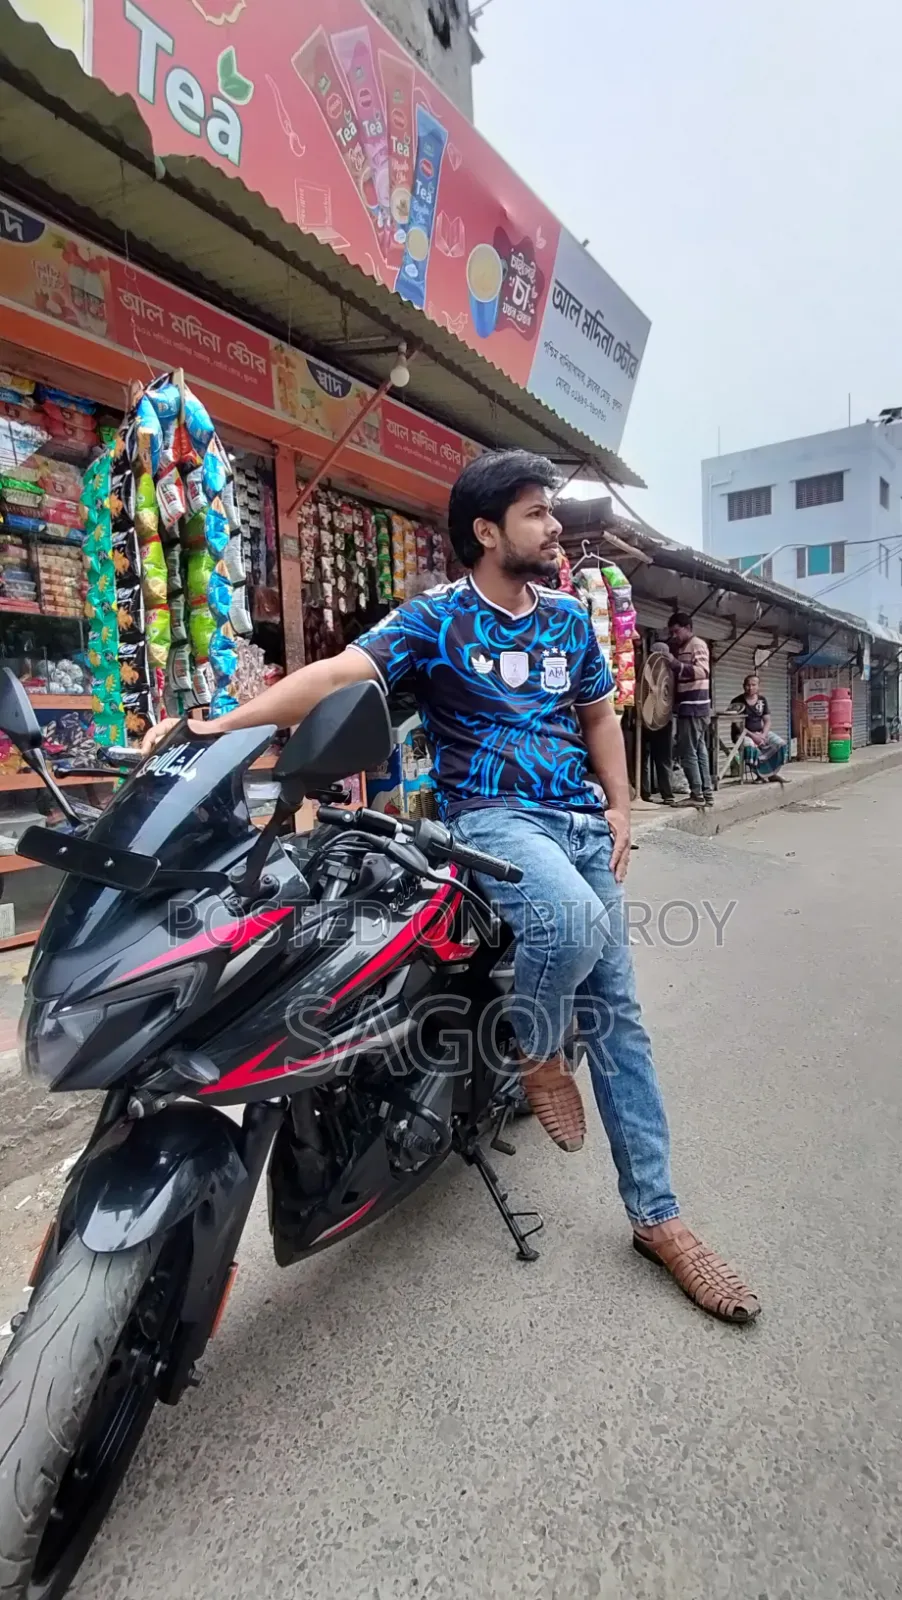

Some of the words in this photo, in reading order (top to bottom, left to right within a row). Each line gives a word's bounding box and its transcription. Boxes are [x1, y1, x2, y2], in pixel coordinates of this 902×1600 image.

[125, 0, 243, 167] Tea
[336, 121, 358, 146] Tea
[363, 119, 383, 137] Tea
[390, 135, 410, 157] Tea
[415, 179, 433, 203] Tea
[512, 275, 531, 311] চা
[117, 287, 165, 328] আল
[169, 312, 221, 354] মদিনা
[551, 279, 583, 329] আল
[581, 308, 615, 358] মদিনা
[315, 368, 343, 398] স্বাদ
[385, 418, 410, 442] আল
[411, 430, 438, 456] মদিনা
